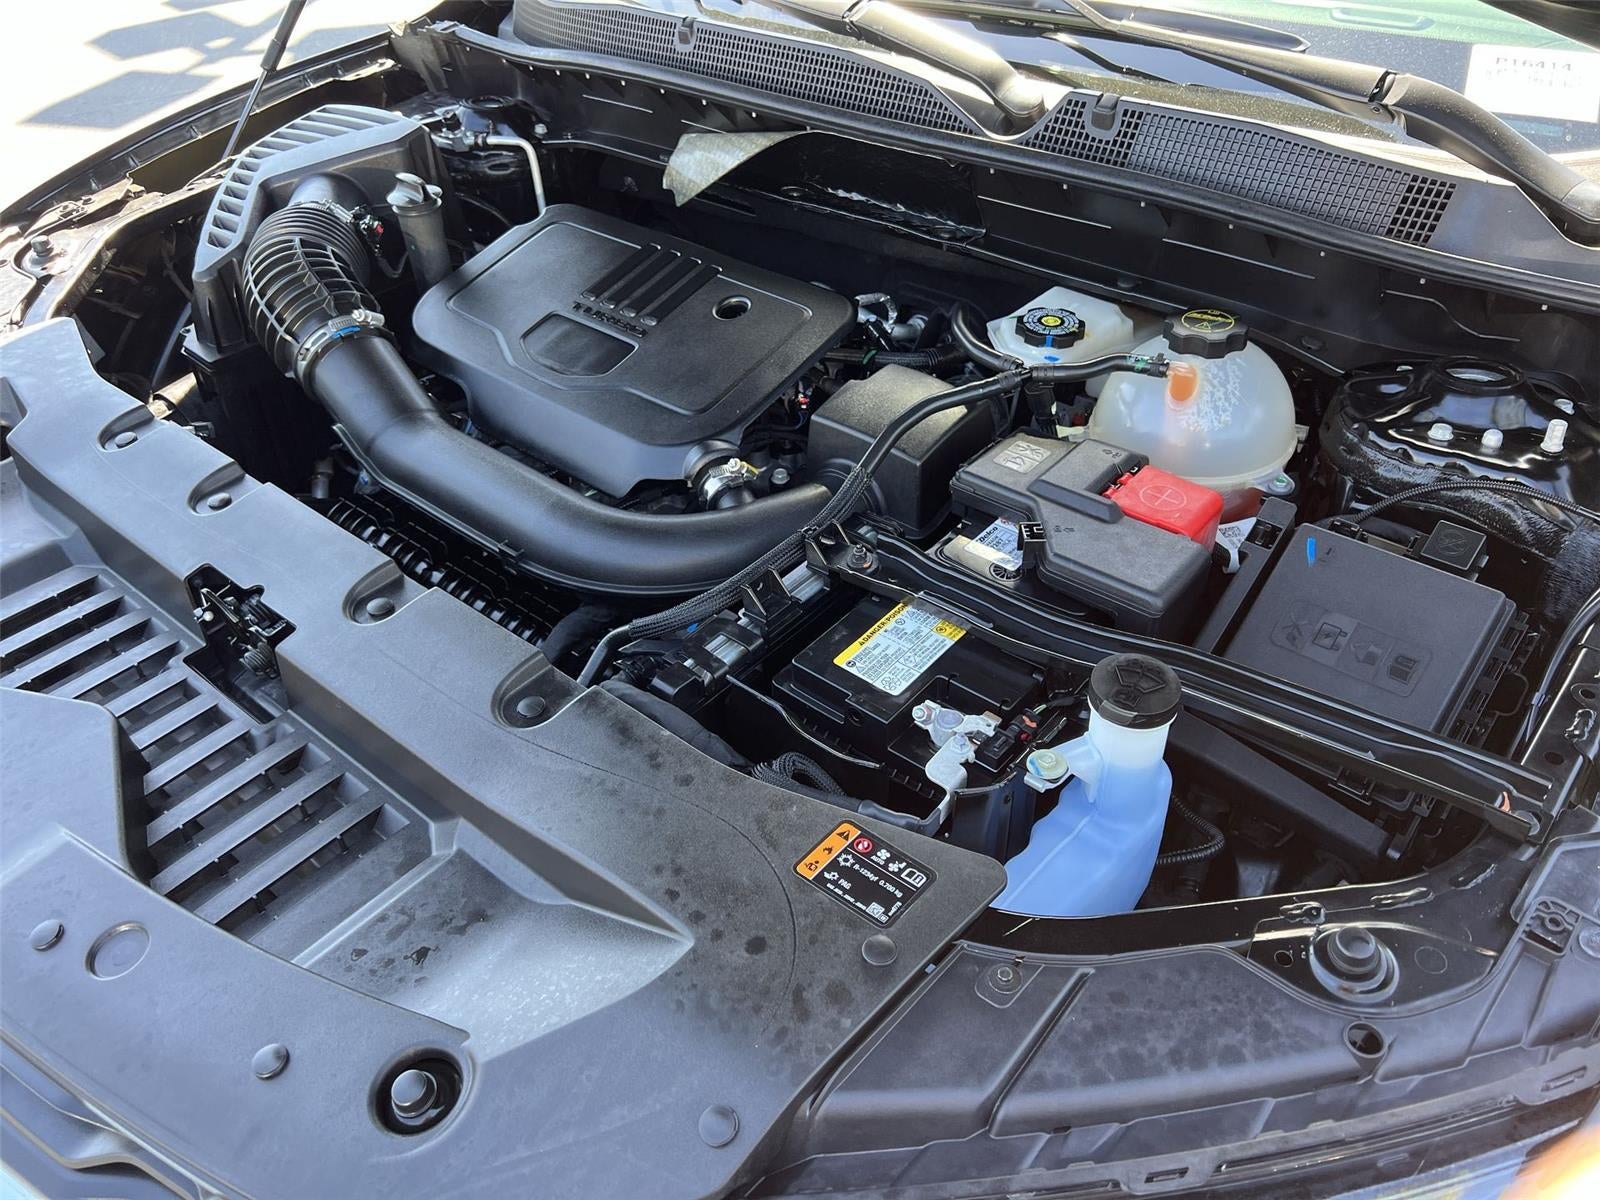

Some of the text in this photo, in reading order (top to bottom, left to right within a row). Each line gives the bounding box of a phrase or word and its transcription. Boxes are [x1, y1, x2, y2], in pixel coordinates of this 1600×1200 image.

[1495, 57, 1572, 71] P16414
[976, 526, 998, 543] Delco
[870, 855, 886, 866] AUTO
[838, 878, 852, 890] PAG
[852, 864, 904, 899] R-1234yf 0.700 kg
